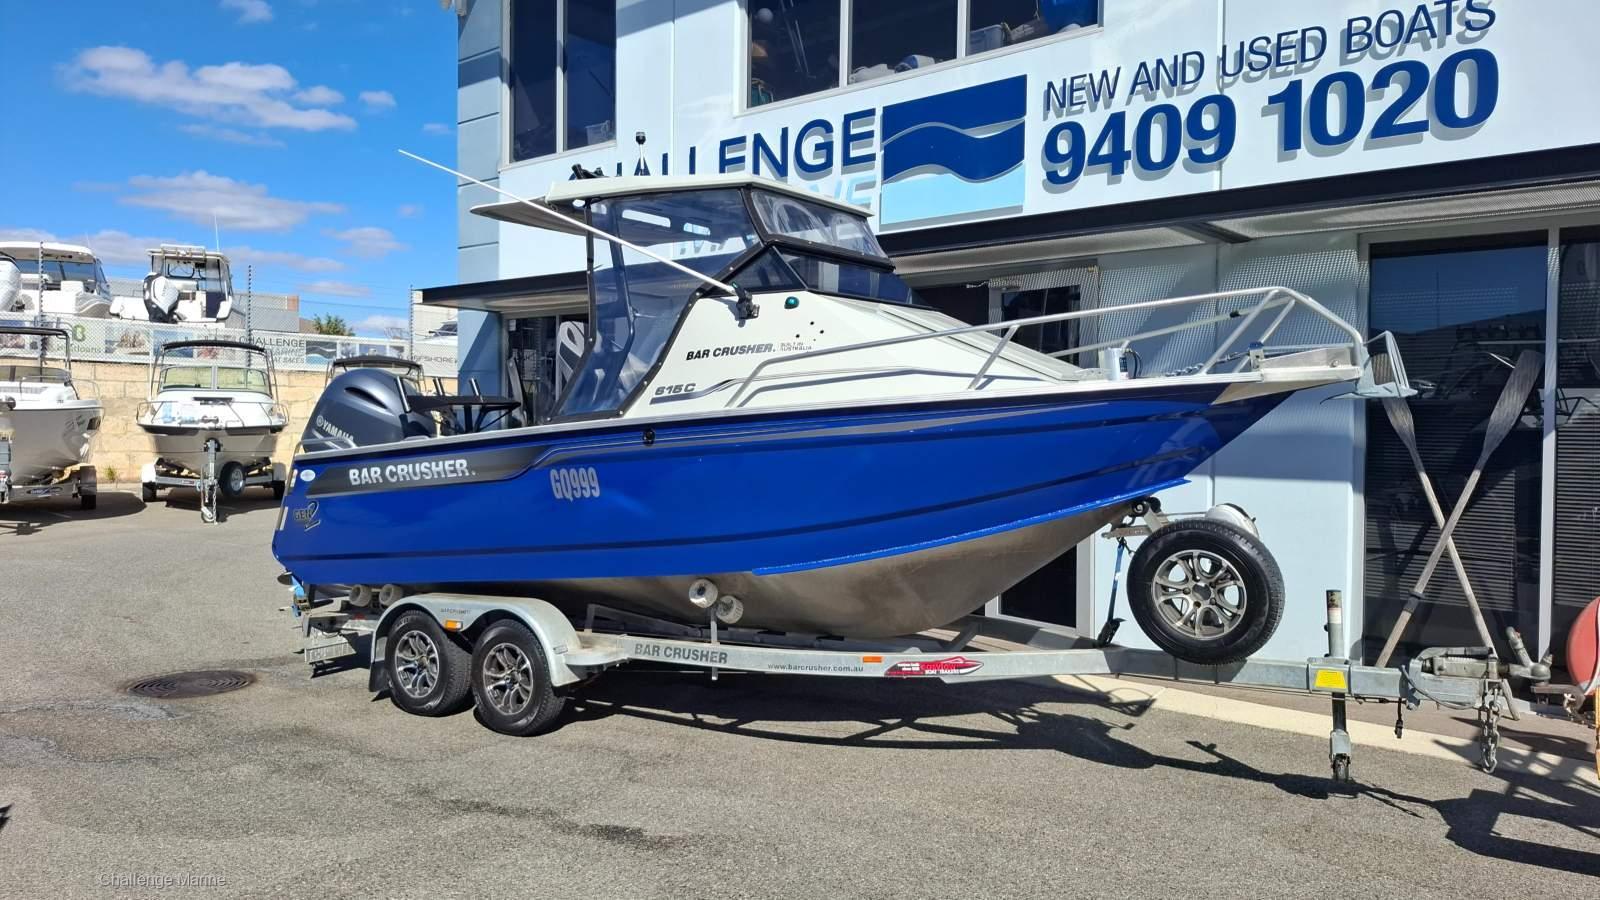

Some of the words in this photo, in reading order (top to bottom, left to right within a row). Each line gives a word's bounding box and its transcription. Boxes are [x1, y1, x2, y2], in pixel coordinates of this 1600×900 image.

[1045, 67, 1121, 112] NEW
[1129, 50, 1205, 96] AND
[1221, 25, 1328, 78] USED
[1345, 0, 1497, 54] BOATS
[1043, 93, 1237, 186] 9409
[1266, 47, 1500, 152] 1020
[568, 107, 877, 182] LENGE
[686, 349, 711, 361] BAR
[348, 466, 383, 486] BAR
[550, 466, 600, 502] GQ999
[634, 642, 662, 657] BAR
[662, 646, 729, 665] CRUSHER
